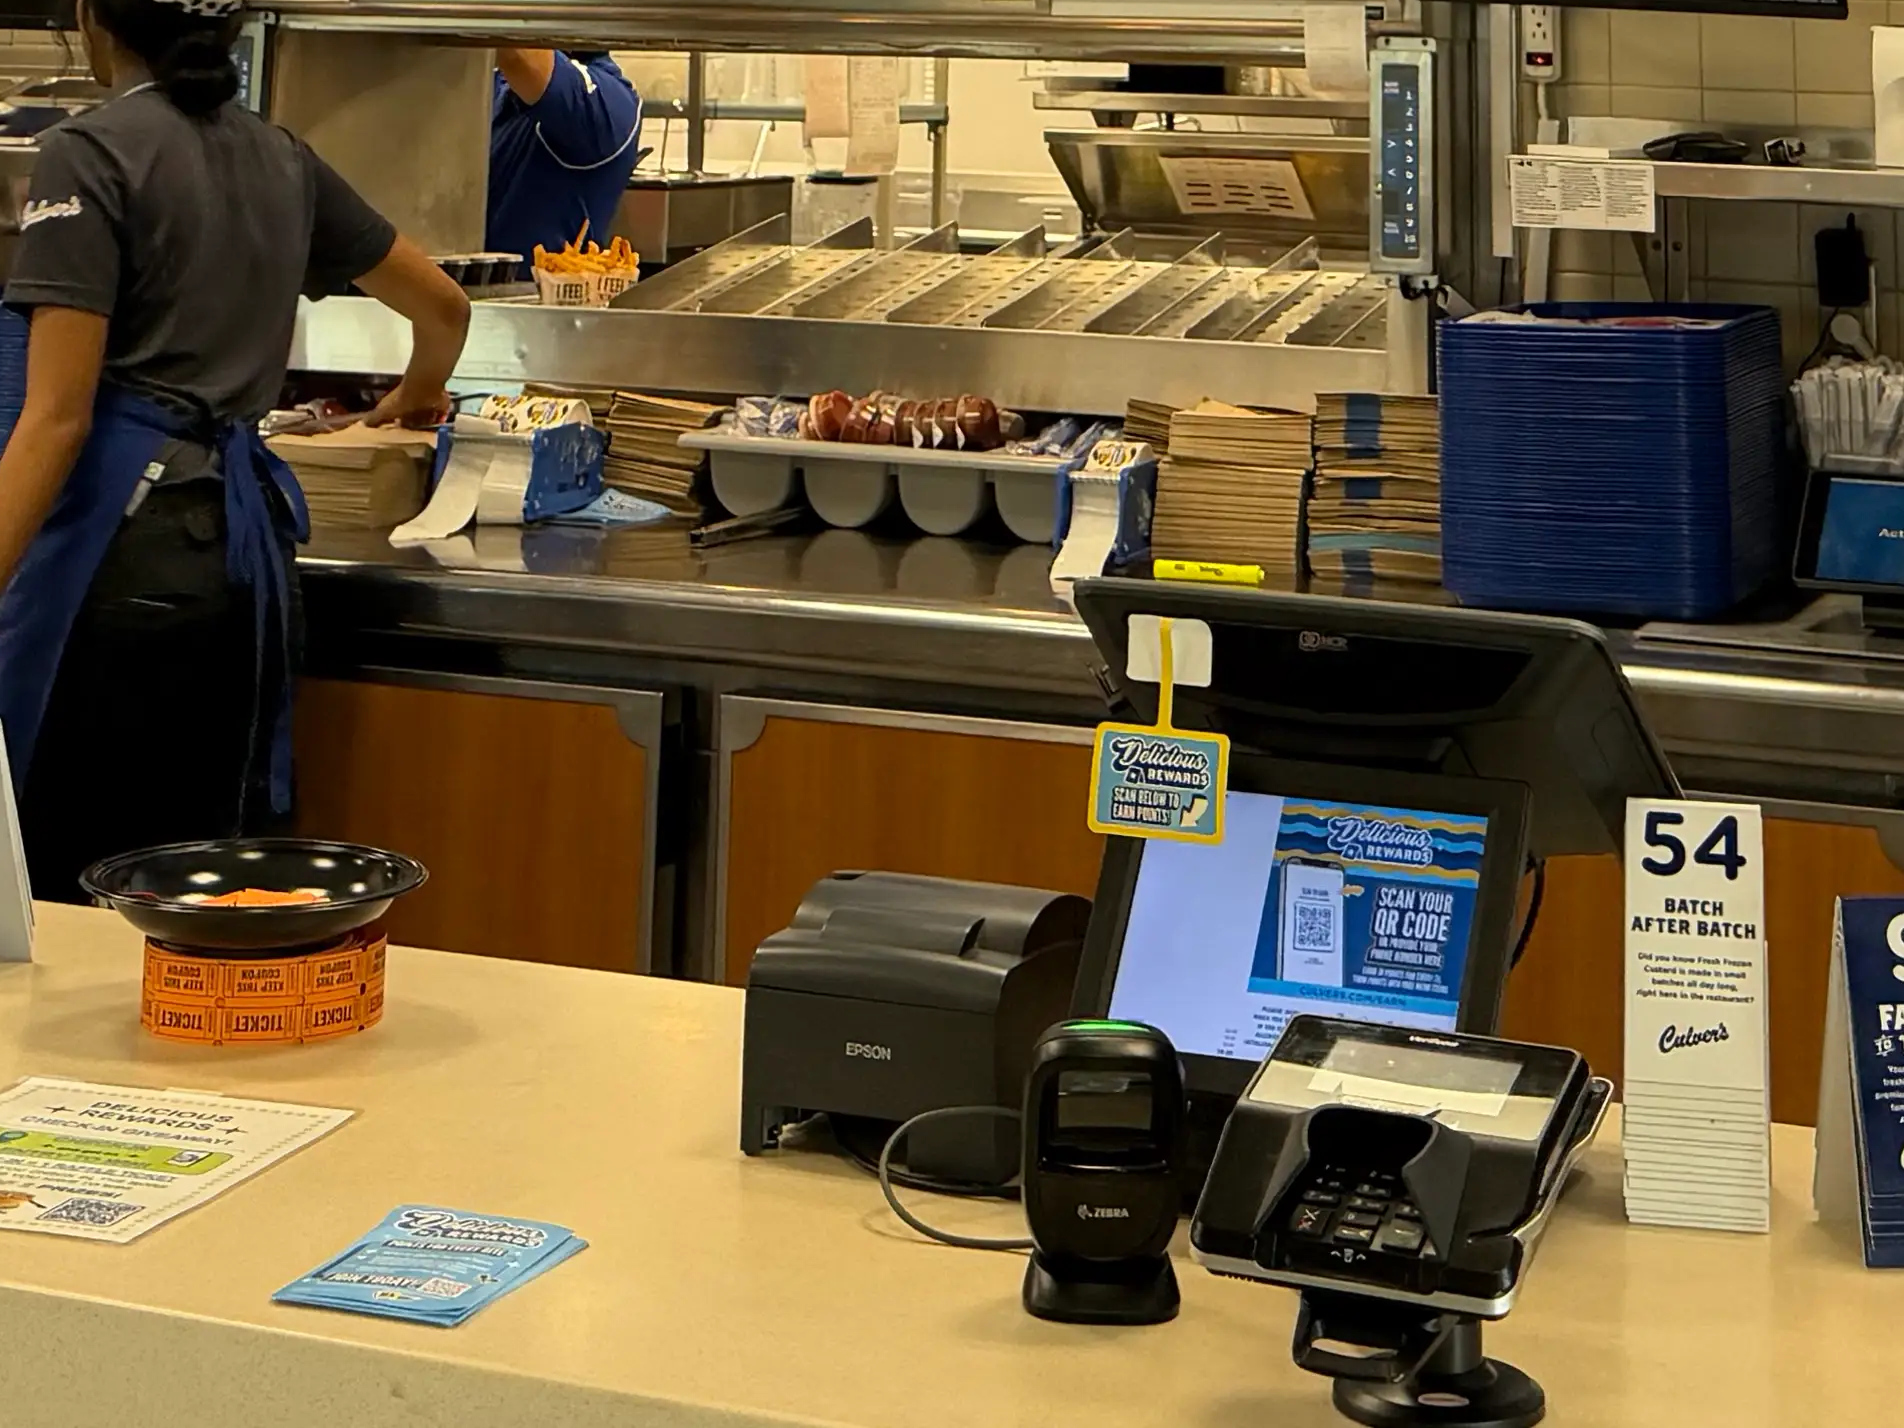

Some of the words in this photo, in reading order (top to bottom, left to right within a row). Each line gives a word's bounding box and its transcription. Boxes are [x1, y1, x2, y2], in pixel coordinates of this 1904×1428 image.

[1642, 811, 1746, 880] 54
[1378, 888, 1415, 909] SCAN
[1419, 892, 1453, 914] YOUR
[1665, 898, 1723, 916] BATCH
[1376, 910, 1399, 935] QR
[1404, 913, 1450, 941] CODE
[1632, 916, 1690, 935] AFTER
[1698, 921, 1756, 939] BATCH
[233, 1015, 284, 1032] TICKET
[1659, 1023, 1729, 1053] Culver's
[846, 1042, 891, 1060] EPSON
[1094, 1208, 1129, 1218] ZEBRA
